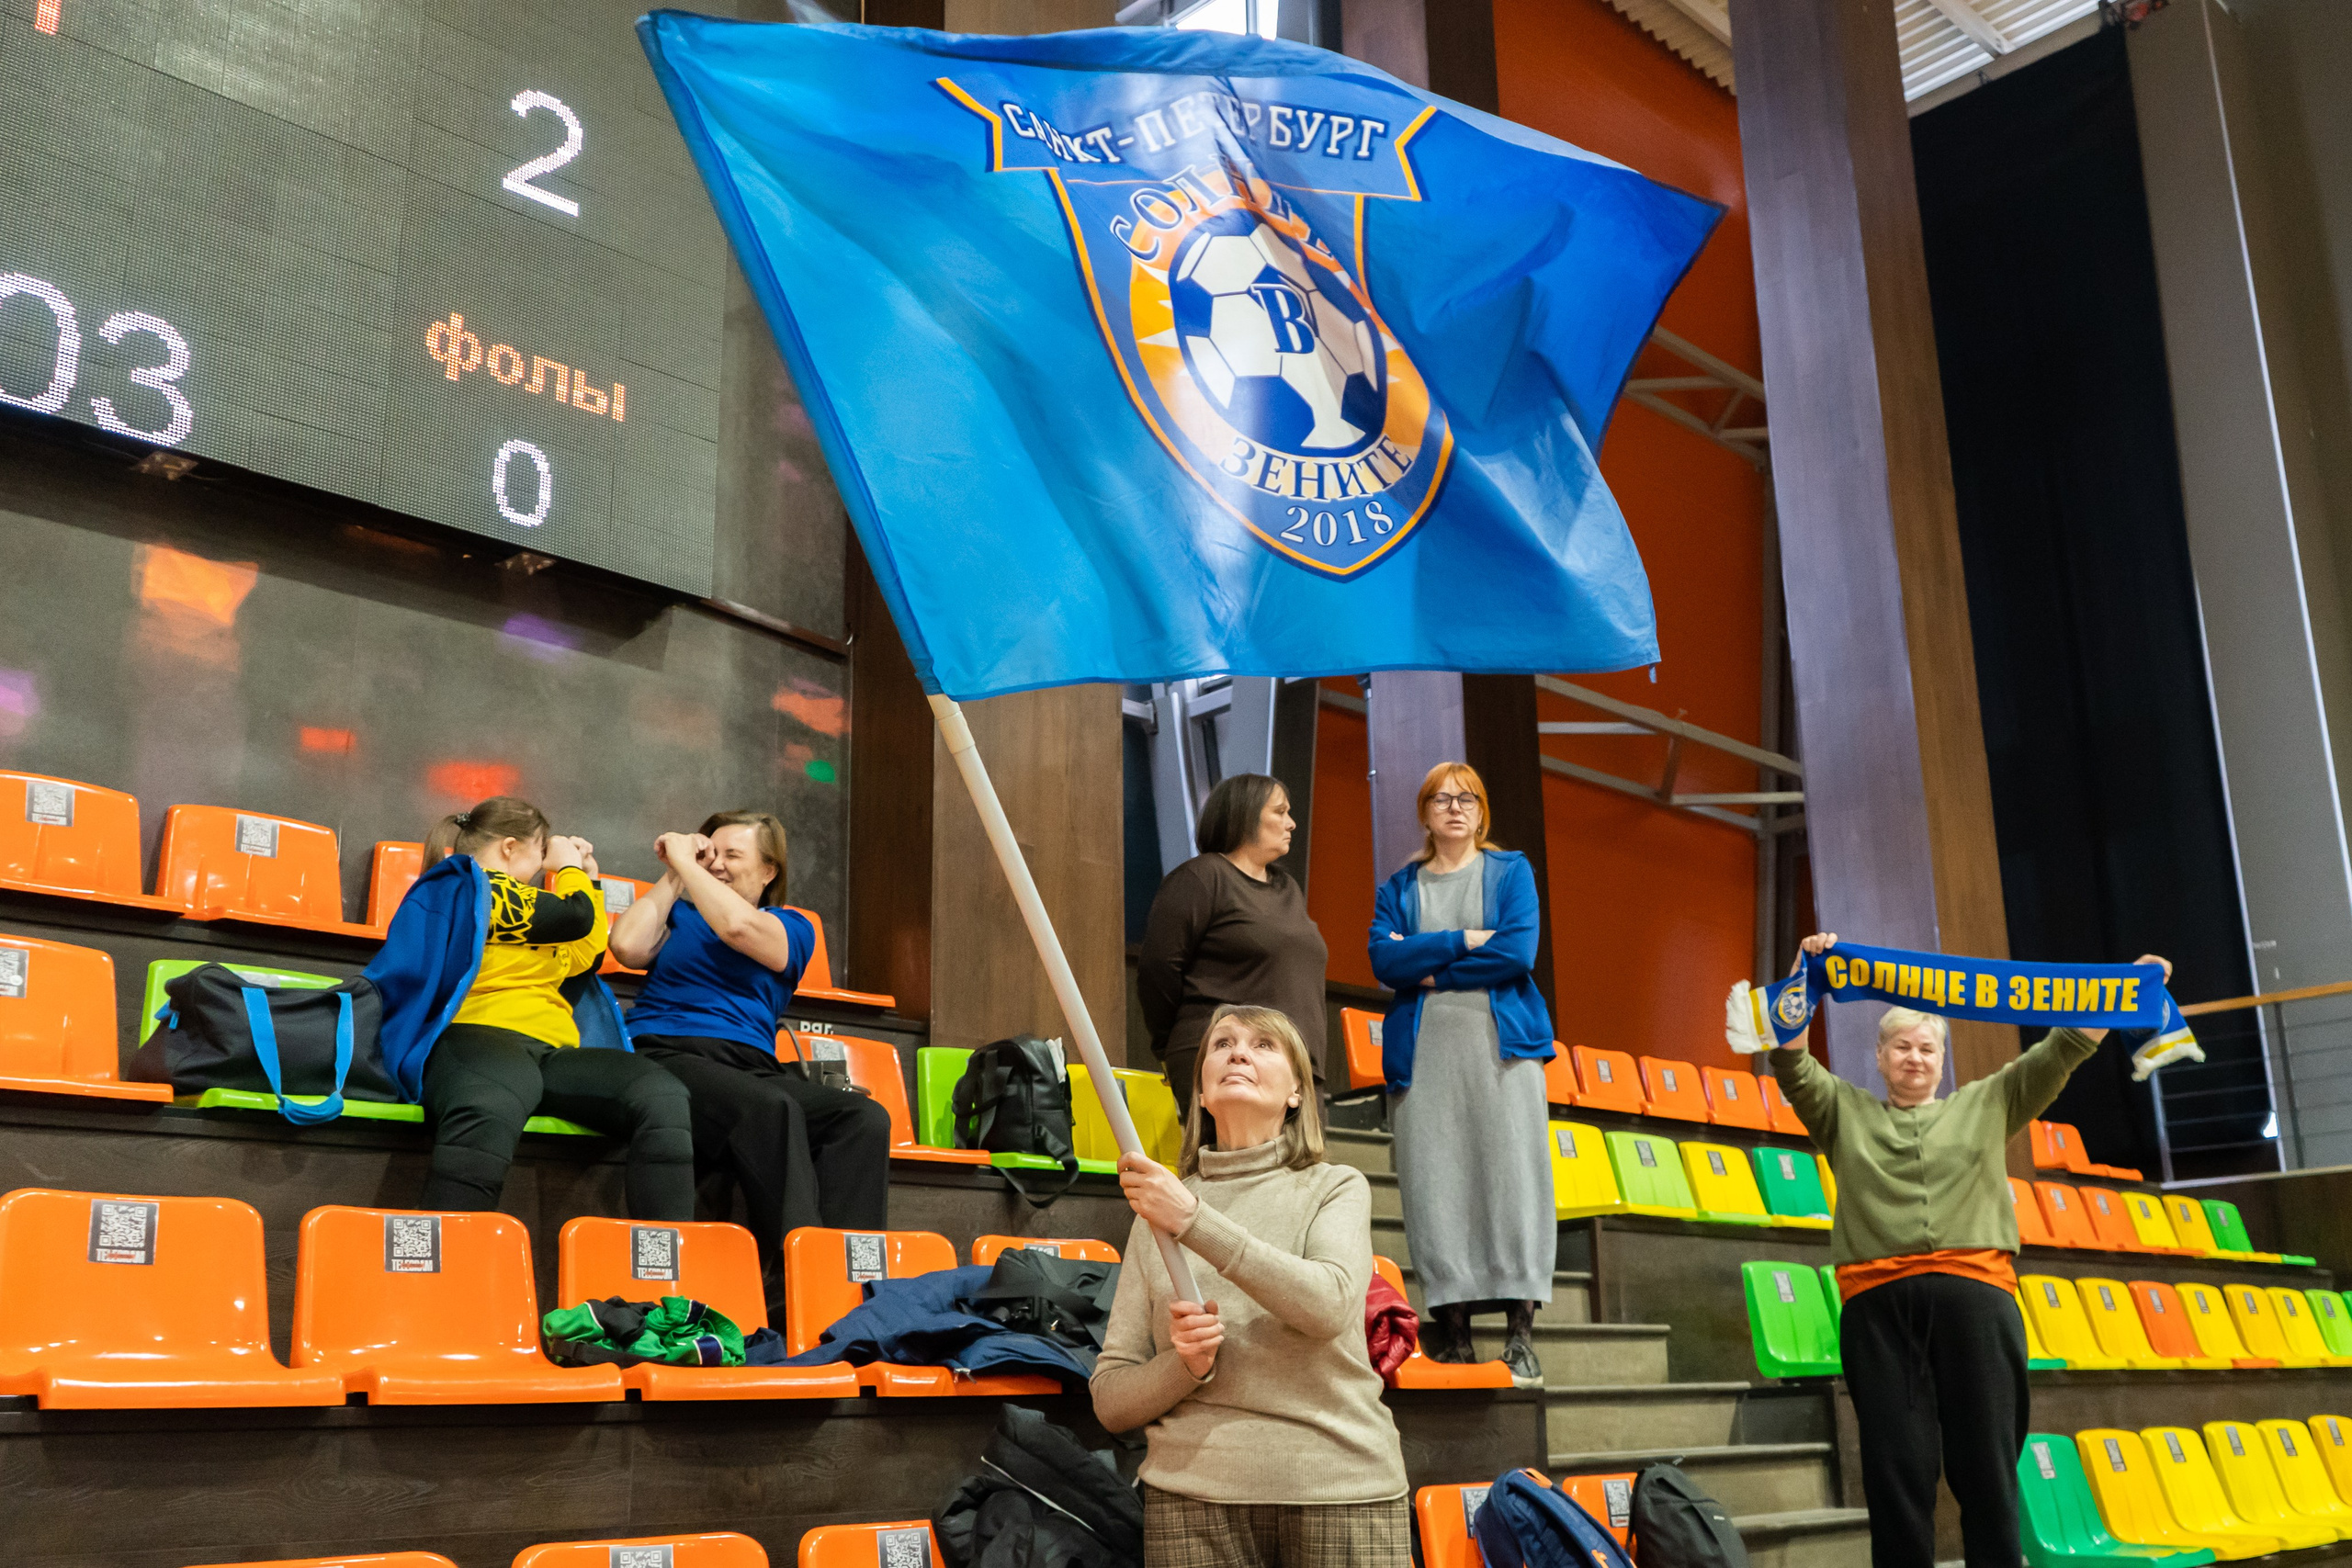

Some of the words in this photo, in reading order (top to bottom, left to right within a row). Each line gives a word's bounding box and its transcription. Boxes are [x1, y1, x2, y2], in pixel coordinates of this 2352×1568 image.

[503, 89, 582, 217] 2
[493, 439, 551, 527] 0
[1219, 434, 1413, 502] ЗЕНИТЕ
[1280, 501, 1394, 547] 2018
[1826, 955, 1966, 1009] СОЛНЦЕ
[1976, 974, 1999, 1010] В
[2009, 976, 2141, 1012] ЗЕНИТЕ
